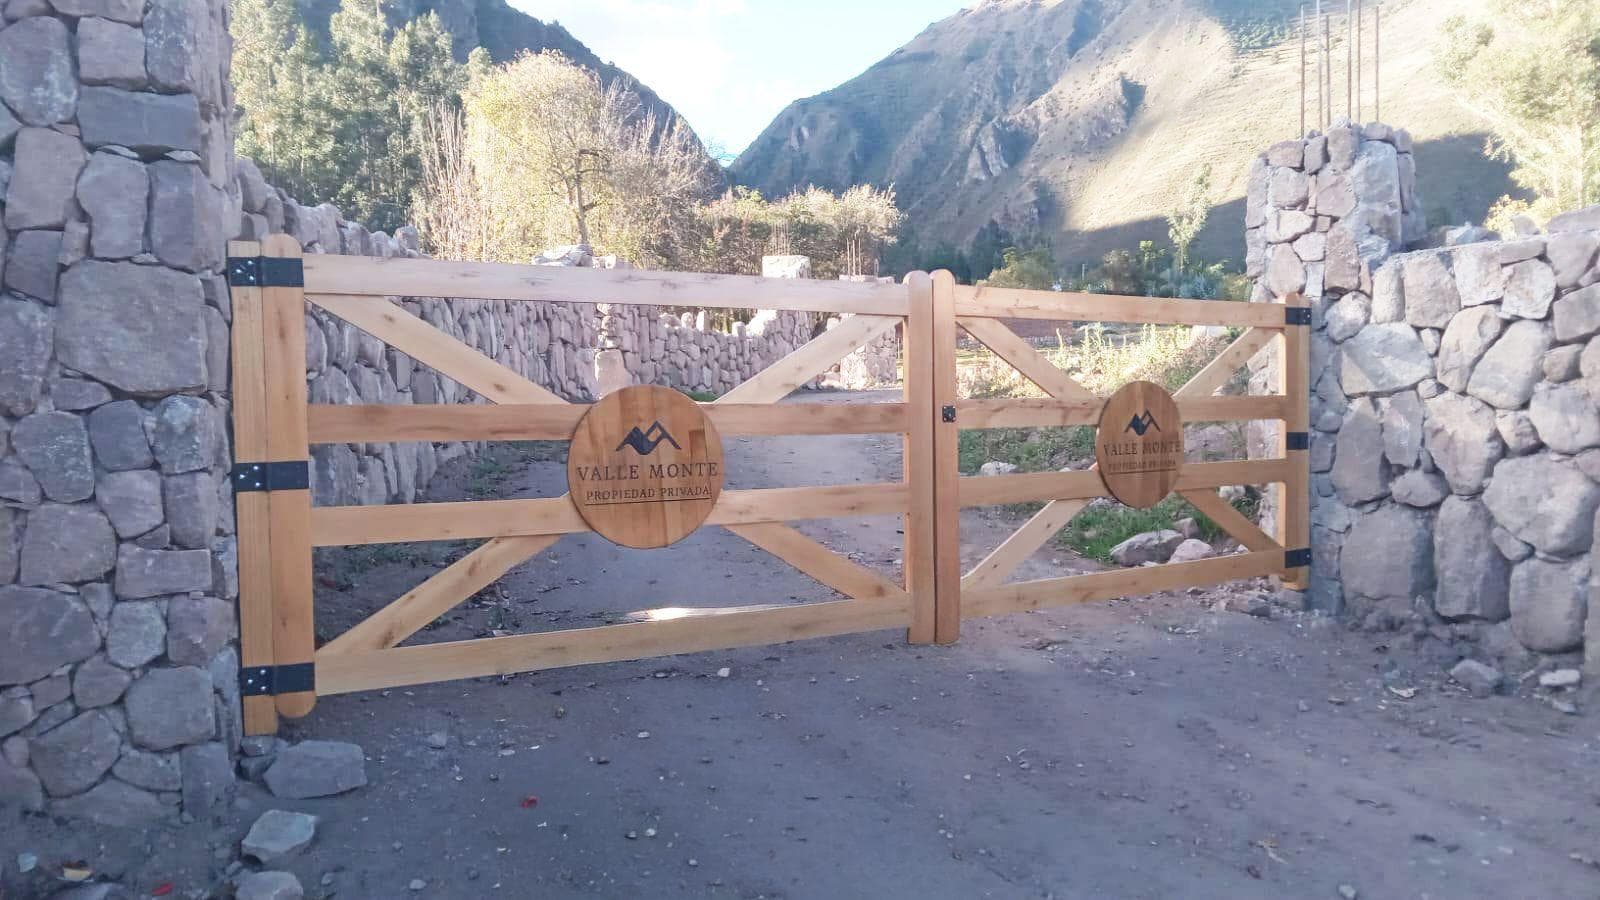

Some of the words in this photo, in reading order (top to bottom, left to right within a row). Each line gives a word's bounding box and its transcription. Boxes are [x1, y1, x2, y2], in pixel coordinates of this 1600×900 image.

[1104, 441, 1137, 456] VALLE
[1143, 439, 1180, 454] MONTE
[576, 465, 639, 481] VALLE
[649, 462, 718, 479] MONTE
[586, 488, 655, 501] PROPIEDAD
[660, 485, 710, 498] PRIVADA
